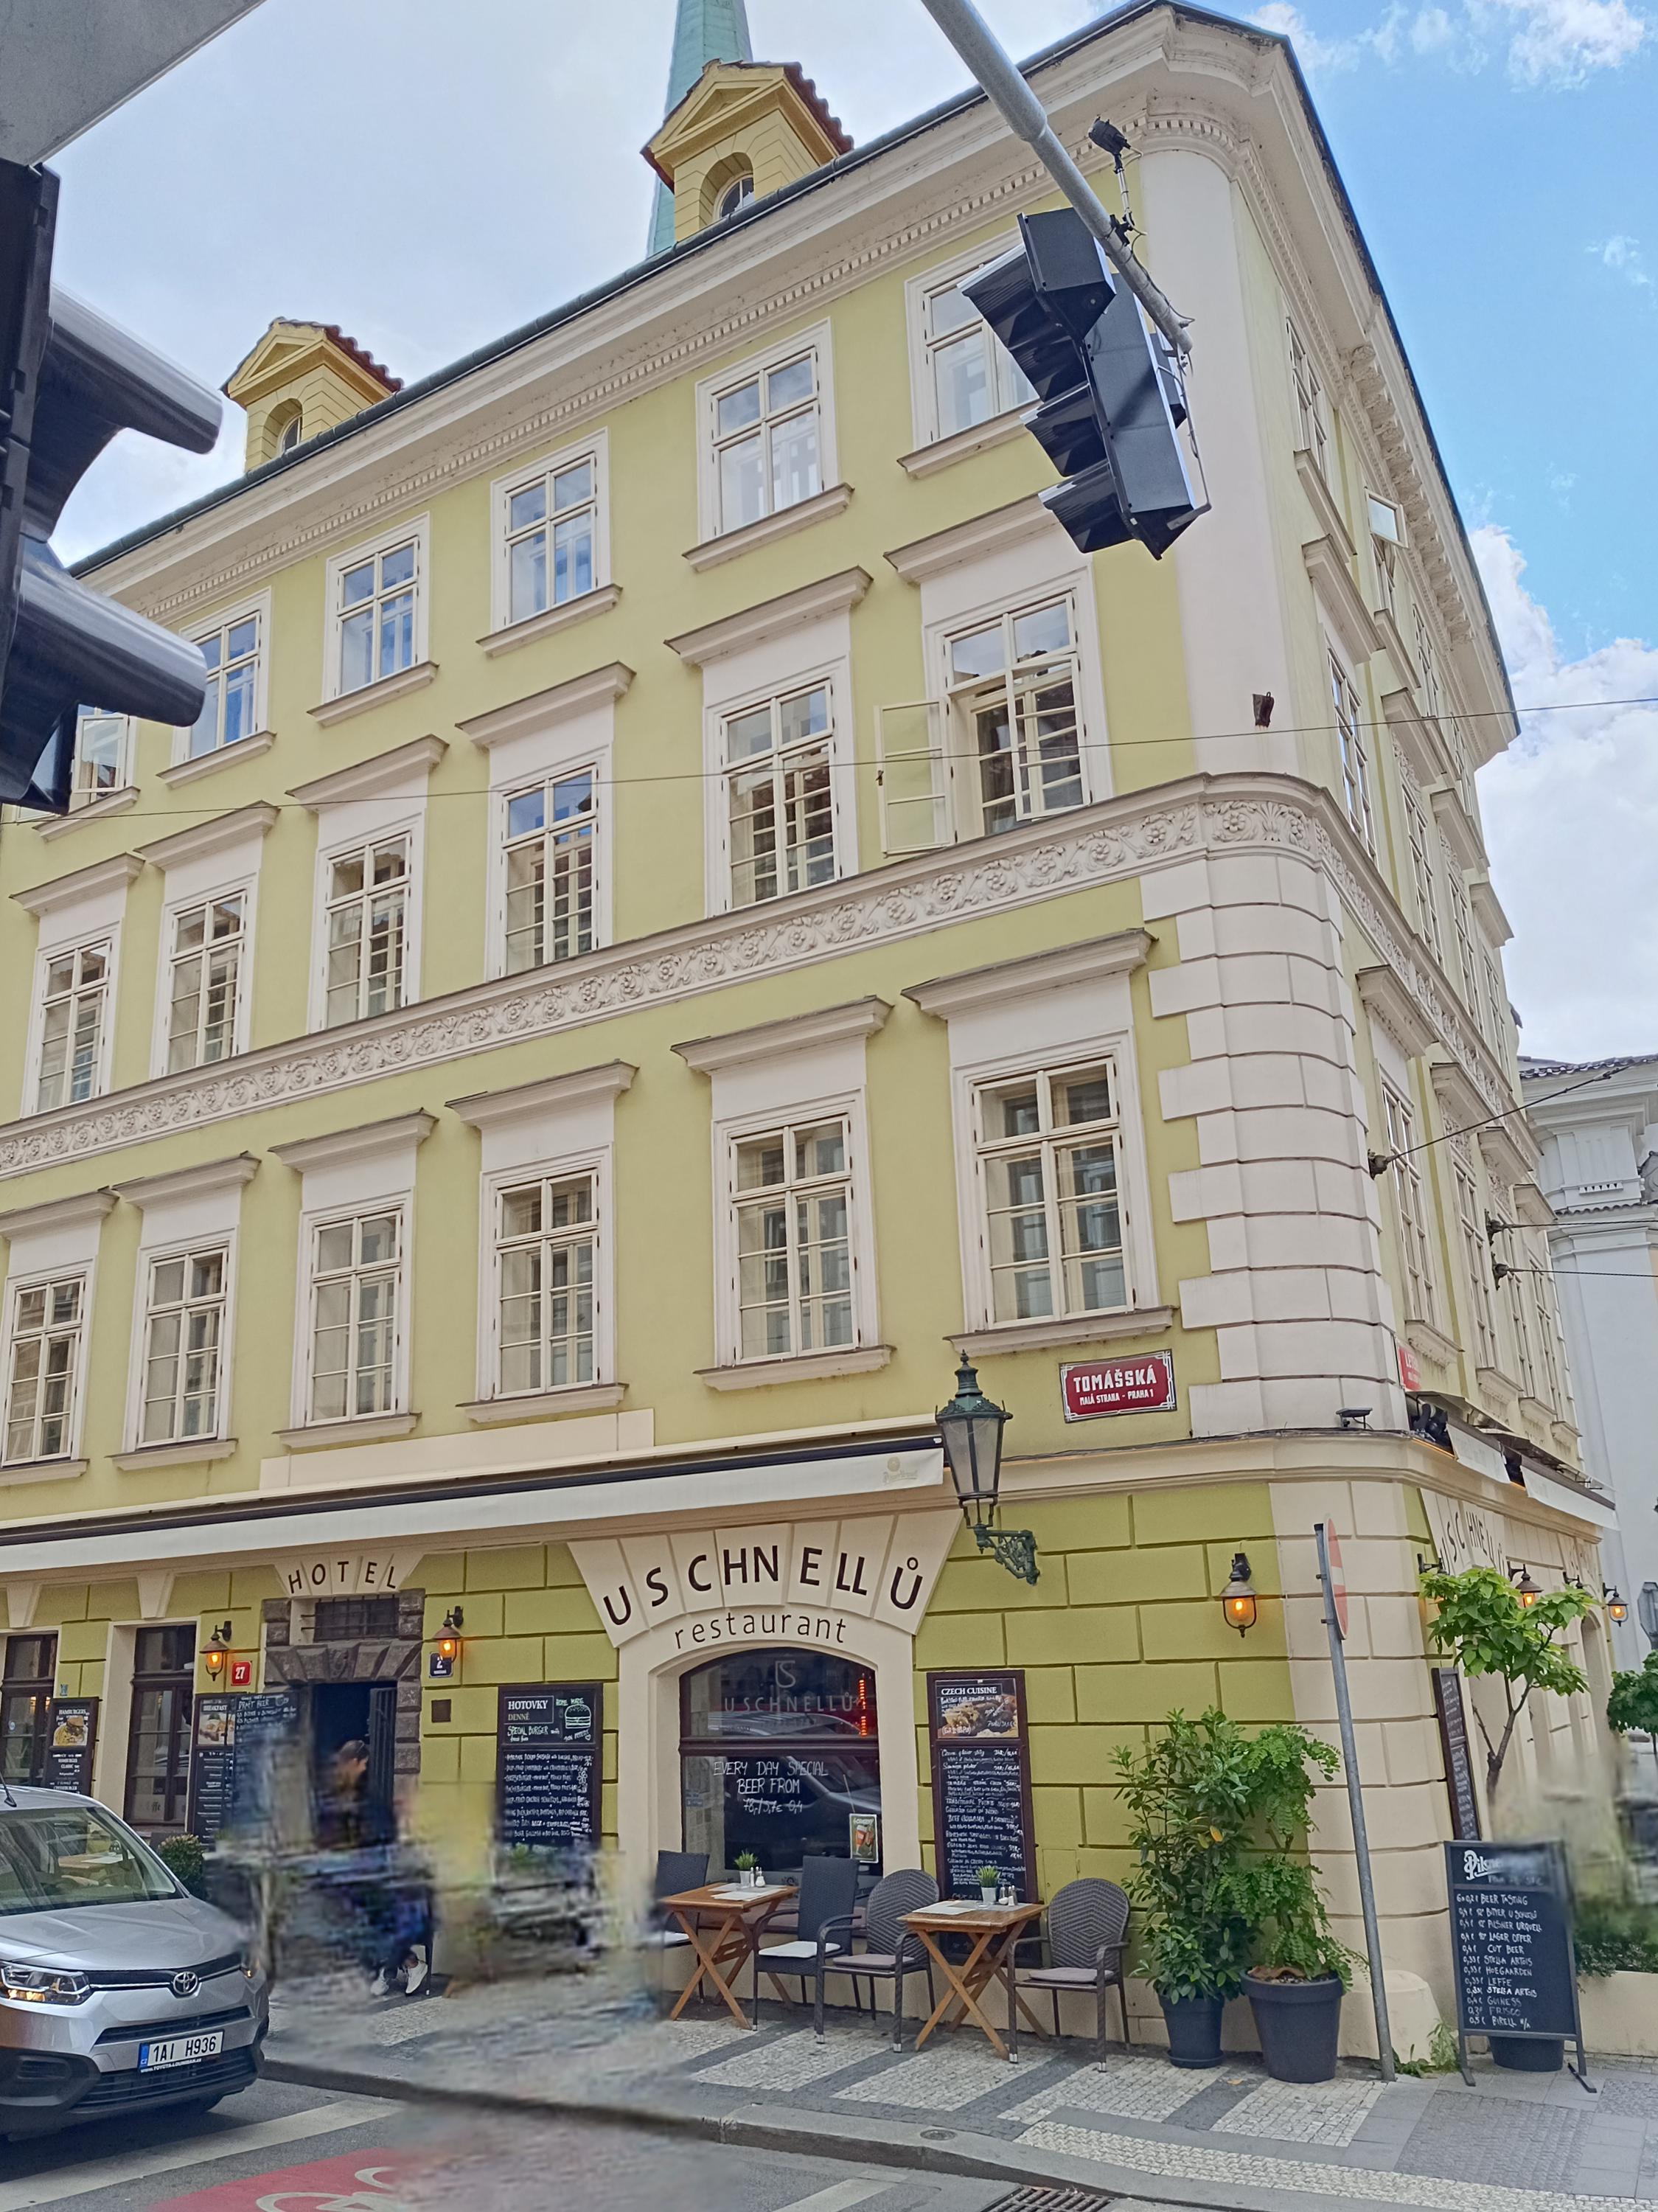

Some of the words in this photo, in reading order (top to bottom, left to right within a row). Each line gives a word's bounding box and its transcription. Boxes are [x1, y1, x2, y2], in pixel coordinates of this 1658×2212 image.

[1073, 1364, 1157, 1393] TOMÁŠSKÁ
[1127, 1389, 1149, 1400] PRAHA
[1149, 1388, 1154, 1397] 1
[288, 1560, 397, 1594] HOTEL
[675, 1611, 846, 1649] restaurant
[235, 1666, 245, 1680] 27
[508, 1700, 548, 1710] HOTOVKY
[713, 1761, 748, 1776] EVERY
[756, 1761, 779, 1776] DAY
[787, 1761, 829, 1776] SPECIAL
[736, 1777, 764, 1794] BEER
[770, 1778, 801, 1794] FROM
[1480, 1893, 1499, 1905] BEER
[1516, 1921, 1542, 1933] URQUELL
[1488, 1932, 1510, 1943] LAGER
[1506, 1944, 1525, 1955] BEER
[1483, 1955, 1507, 1965] STELLA
[1485, 1966, 1533, 1976] HOEGAARDEN
[1488, 1977, 1513, 1987] LEFFE
[1487, 1995, 1522, 2006] GUINESS
[185, 2036, 217, 2057] H936
